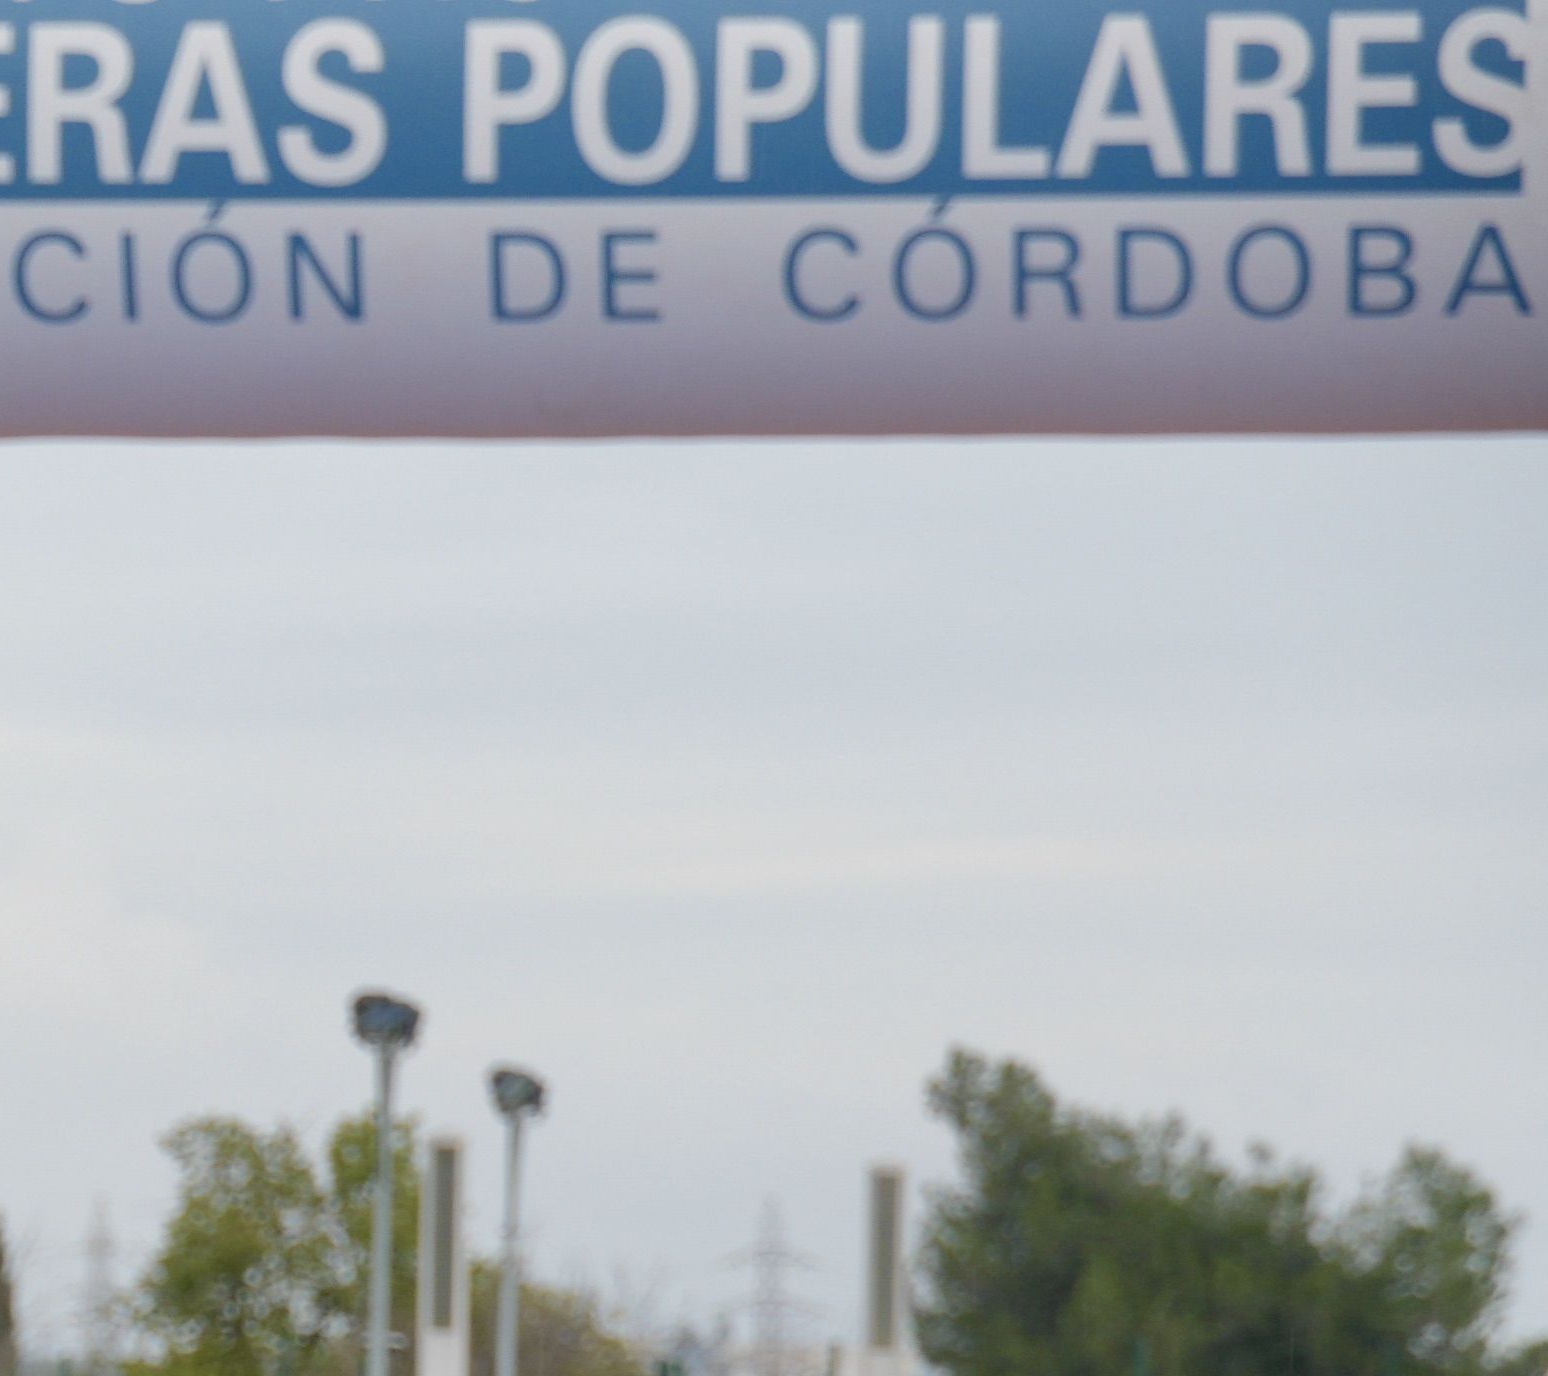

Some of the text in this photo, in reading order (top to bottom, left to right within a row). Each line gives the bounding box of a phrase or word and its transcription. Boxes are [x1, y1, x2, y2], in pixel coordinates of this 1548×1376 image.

[460, 8, 1530, 188] POPULARES
[489, 230, 664, 324] DE
[781, 196, 1536, 322] CÓRDOBA
